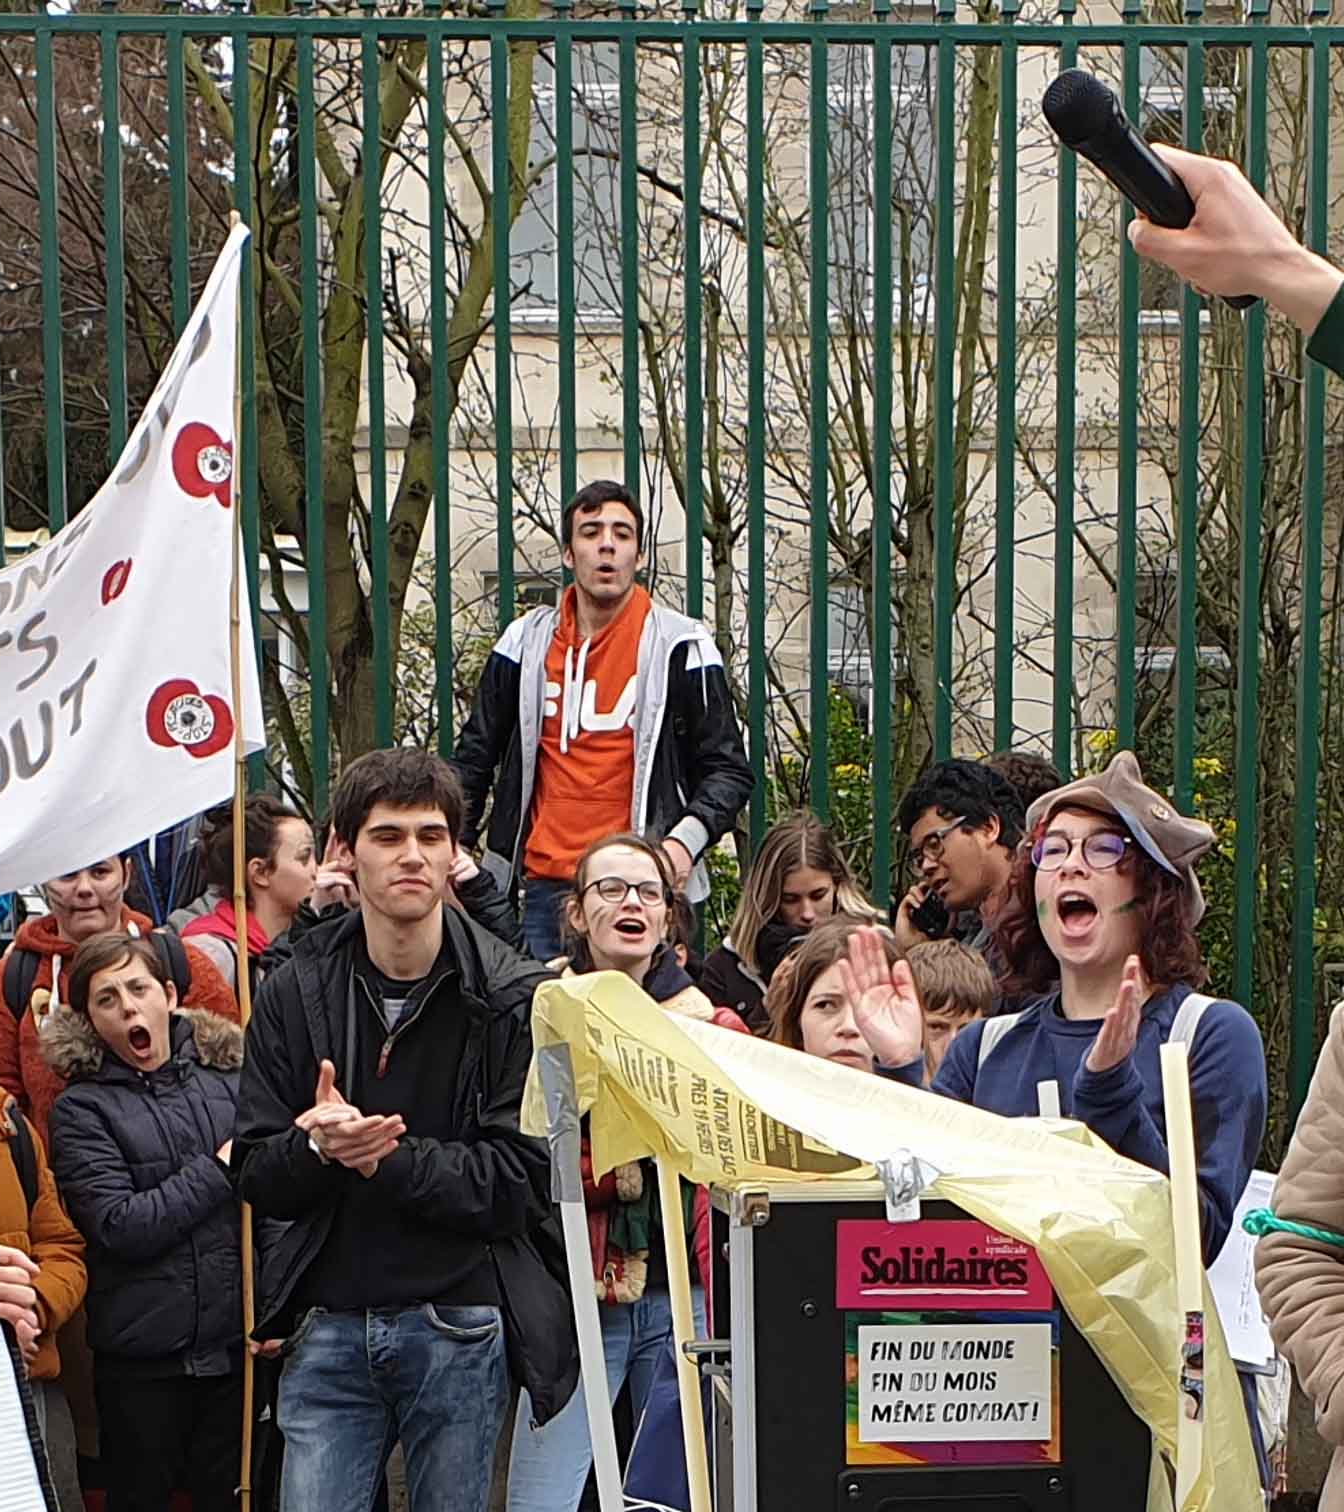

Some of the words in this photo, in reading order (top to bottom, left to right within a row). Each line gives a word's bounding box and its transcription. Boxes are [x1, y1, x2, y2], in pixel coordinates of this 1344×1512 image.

[860, 1246, 1029, 1286] Solidaires
[870, 1341, 903, 1361] FIN
[909, 1341, 935, 1361] DU
[941, 1339, 1016, 1361] MONDE
[871, 1372, 904, 1392] FIN
[909, 1372, 937, 1392] DU
[943, 1370, 998, 1391] MOIS
[870, 1400, 937, 1423] MÊME
